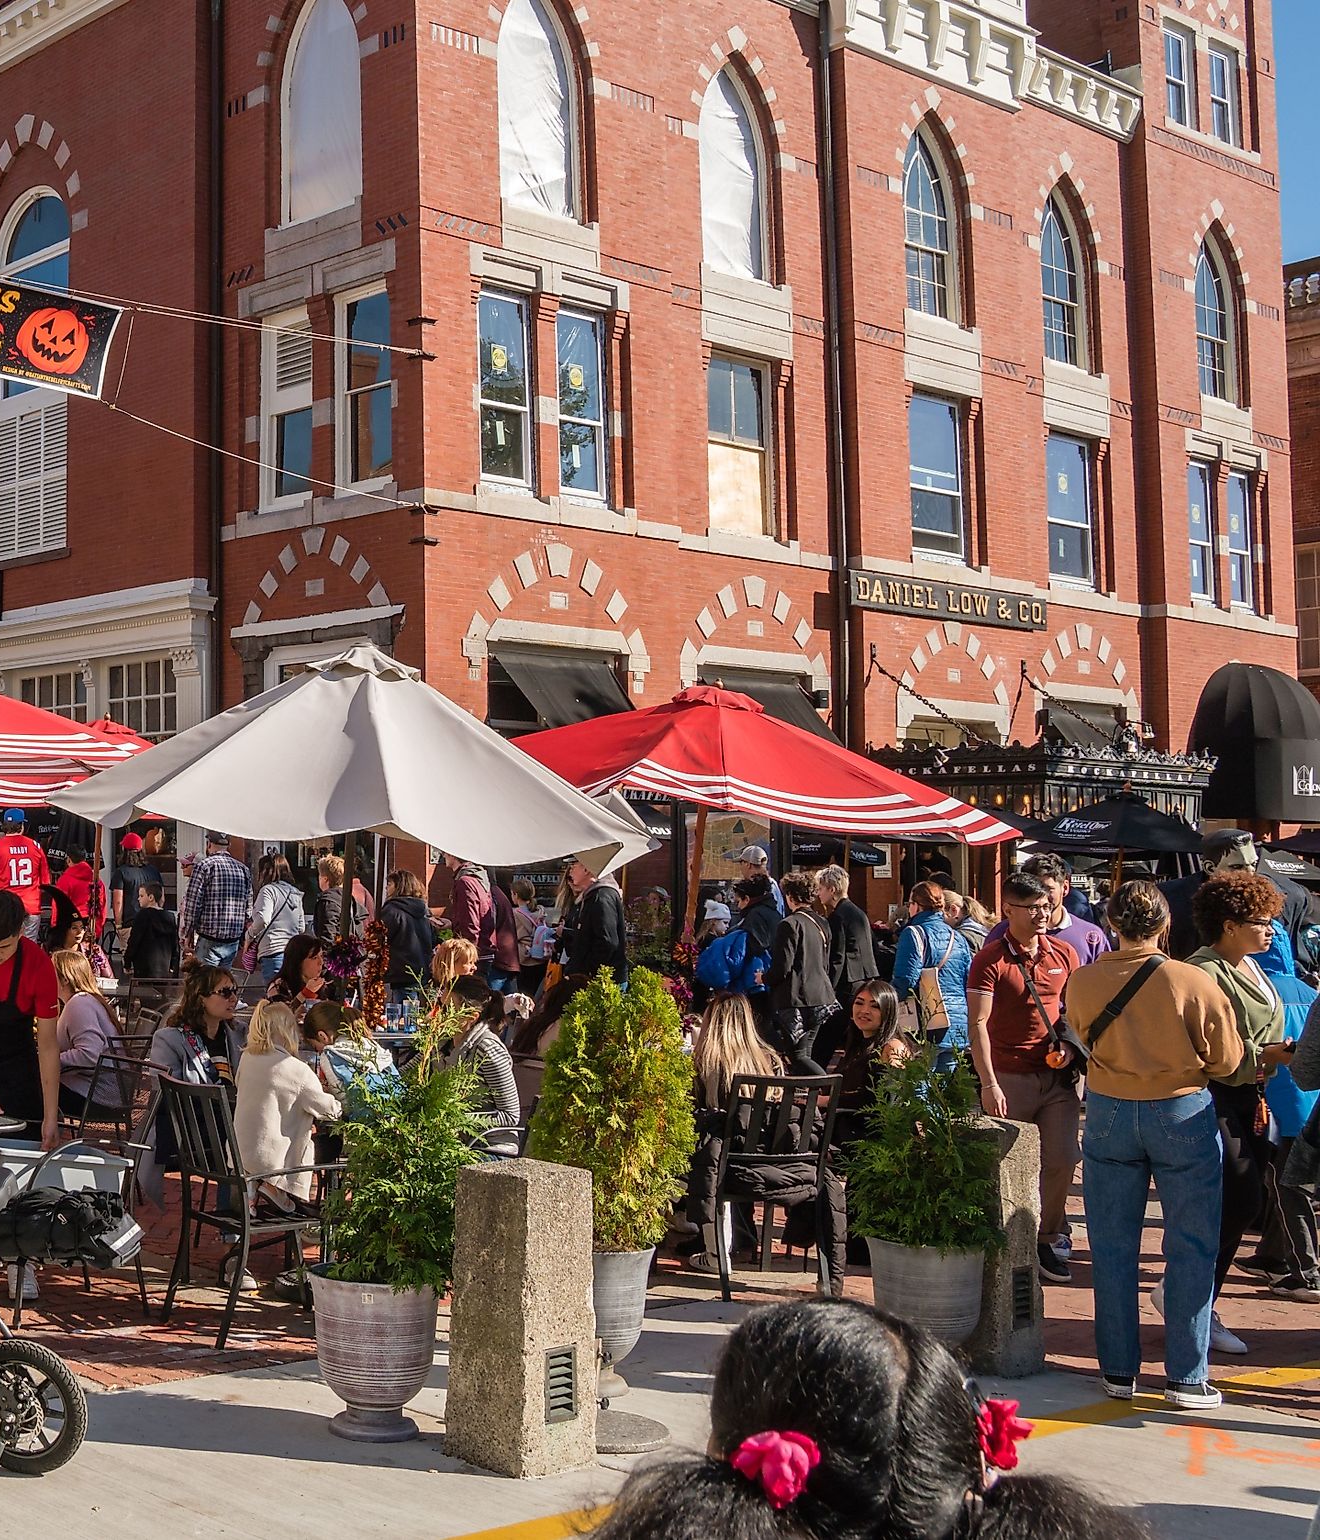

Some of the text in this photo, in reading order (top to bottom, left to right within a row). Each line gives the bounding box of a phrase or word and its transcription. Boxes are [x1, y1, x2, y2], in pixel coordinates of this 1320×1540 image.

[856, 576, 1047, 625] DANIEL LOW & CO.
[893, 763, 1037, 776] OCKAFELLAS
[9, 846, 28, 855] BRADY
[9, 858, 33, 887] 12
